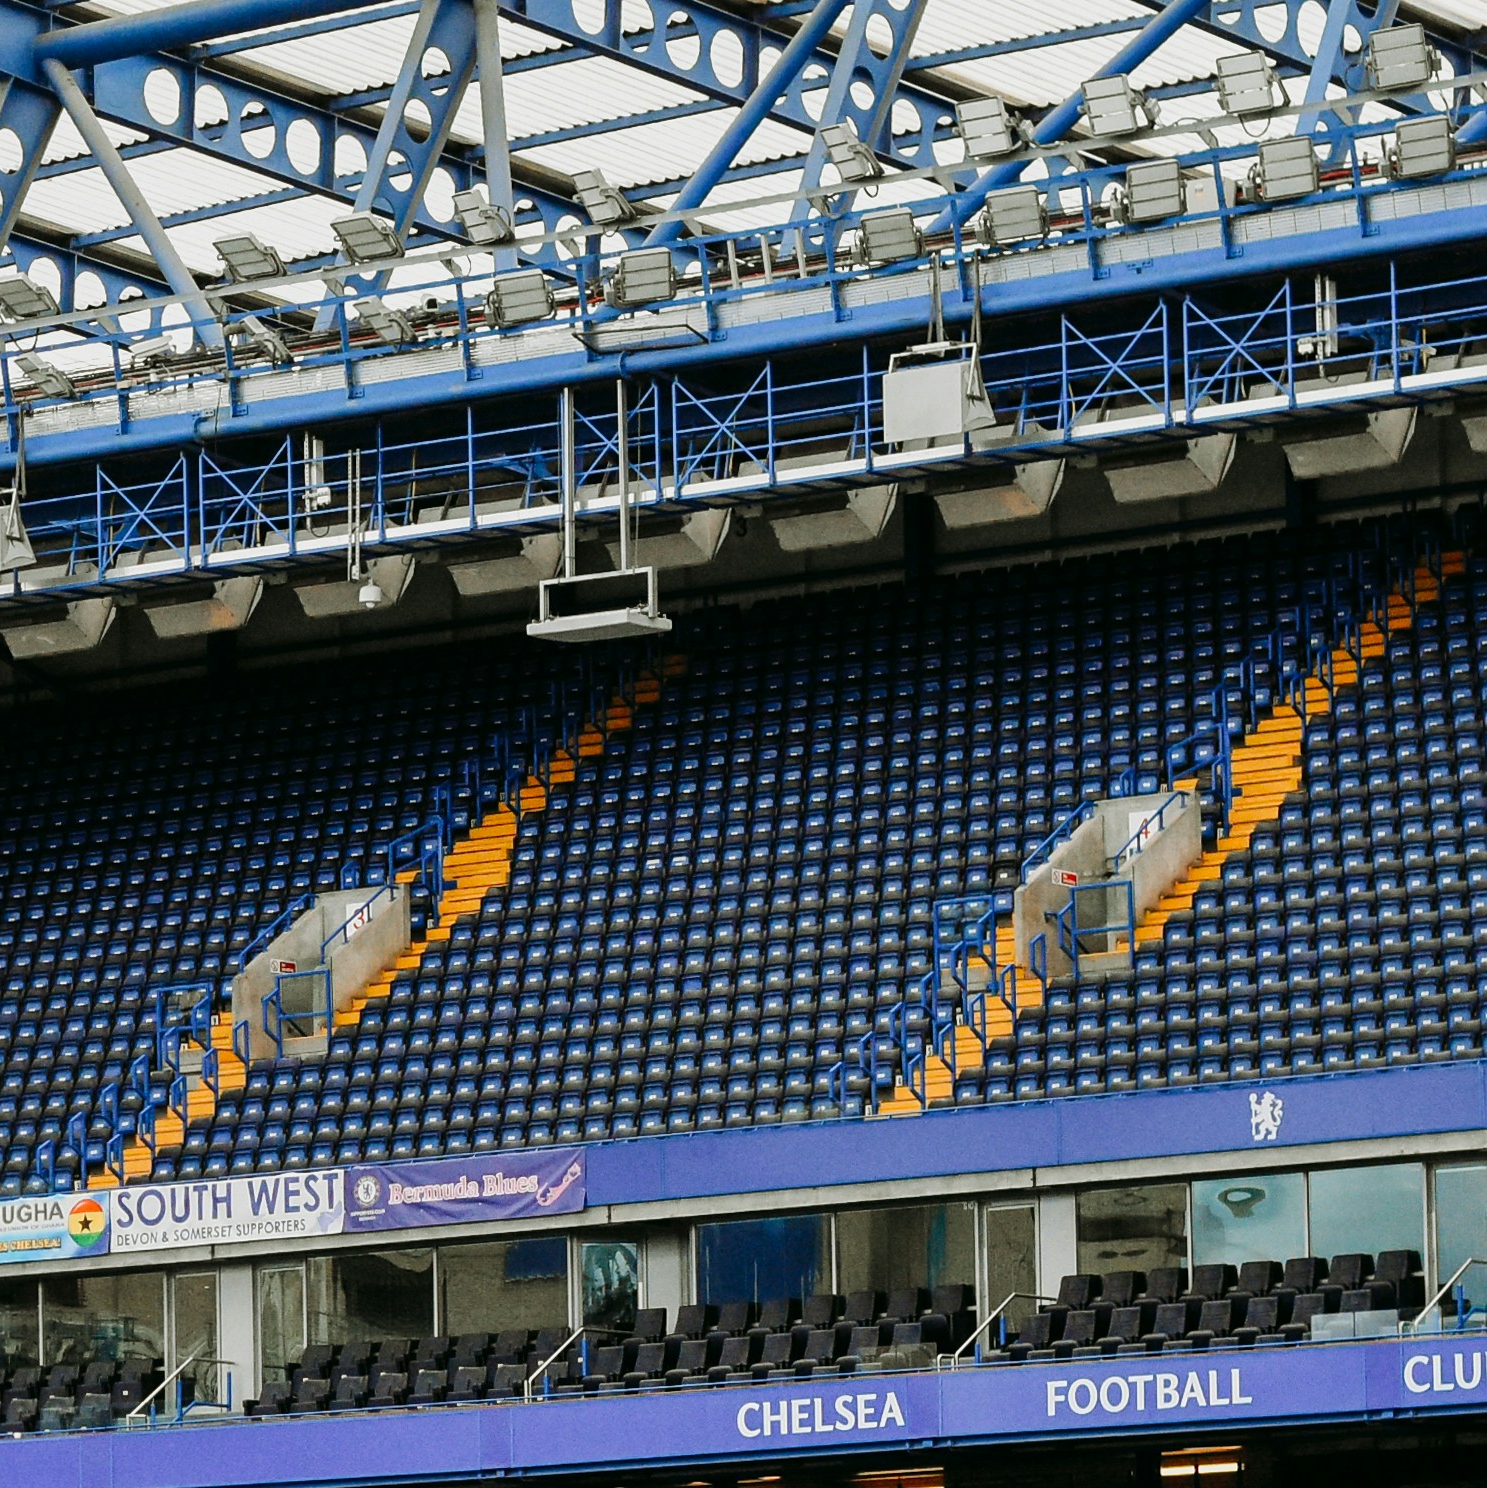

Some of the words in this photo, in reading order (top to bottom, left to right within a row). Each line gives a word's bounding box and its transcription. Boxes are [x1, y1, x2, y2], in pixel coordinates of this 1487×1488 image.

[353, 908, 366, 930] 3
[117, 1182, 231, 1228] SOUTH
[248, 1173, 338, 1216] WEST
[388, 1176, 478, 1205] Bermuda
[482, 1172, 538, 1196] Blues
[11, 1238, 61, 1250] CHELSEA!
[117, 1232, 157, 1246] DEVON
[162, 1230, 168, 1242] &
[174, 1226, 232, 1242] SOMERSET
[236, 1219, 306, 1237] SUPPORTERS
[736, 1392, 904, 1438] CHELSEA
[1046, 1368, 1252, 1417] FOOTBALL
[1404, 1351, 1487, 1394] CLU
